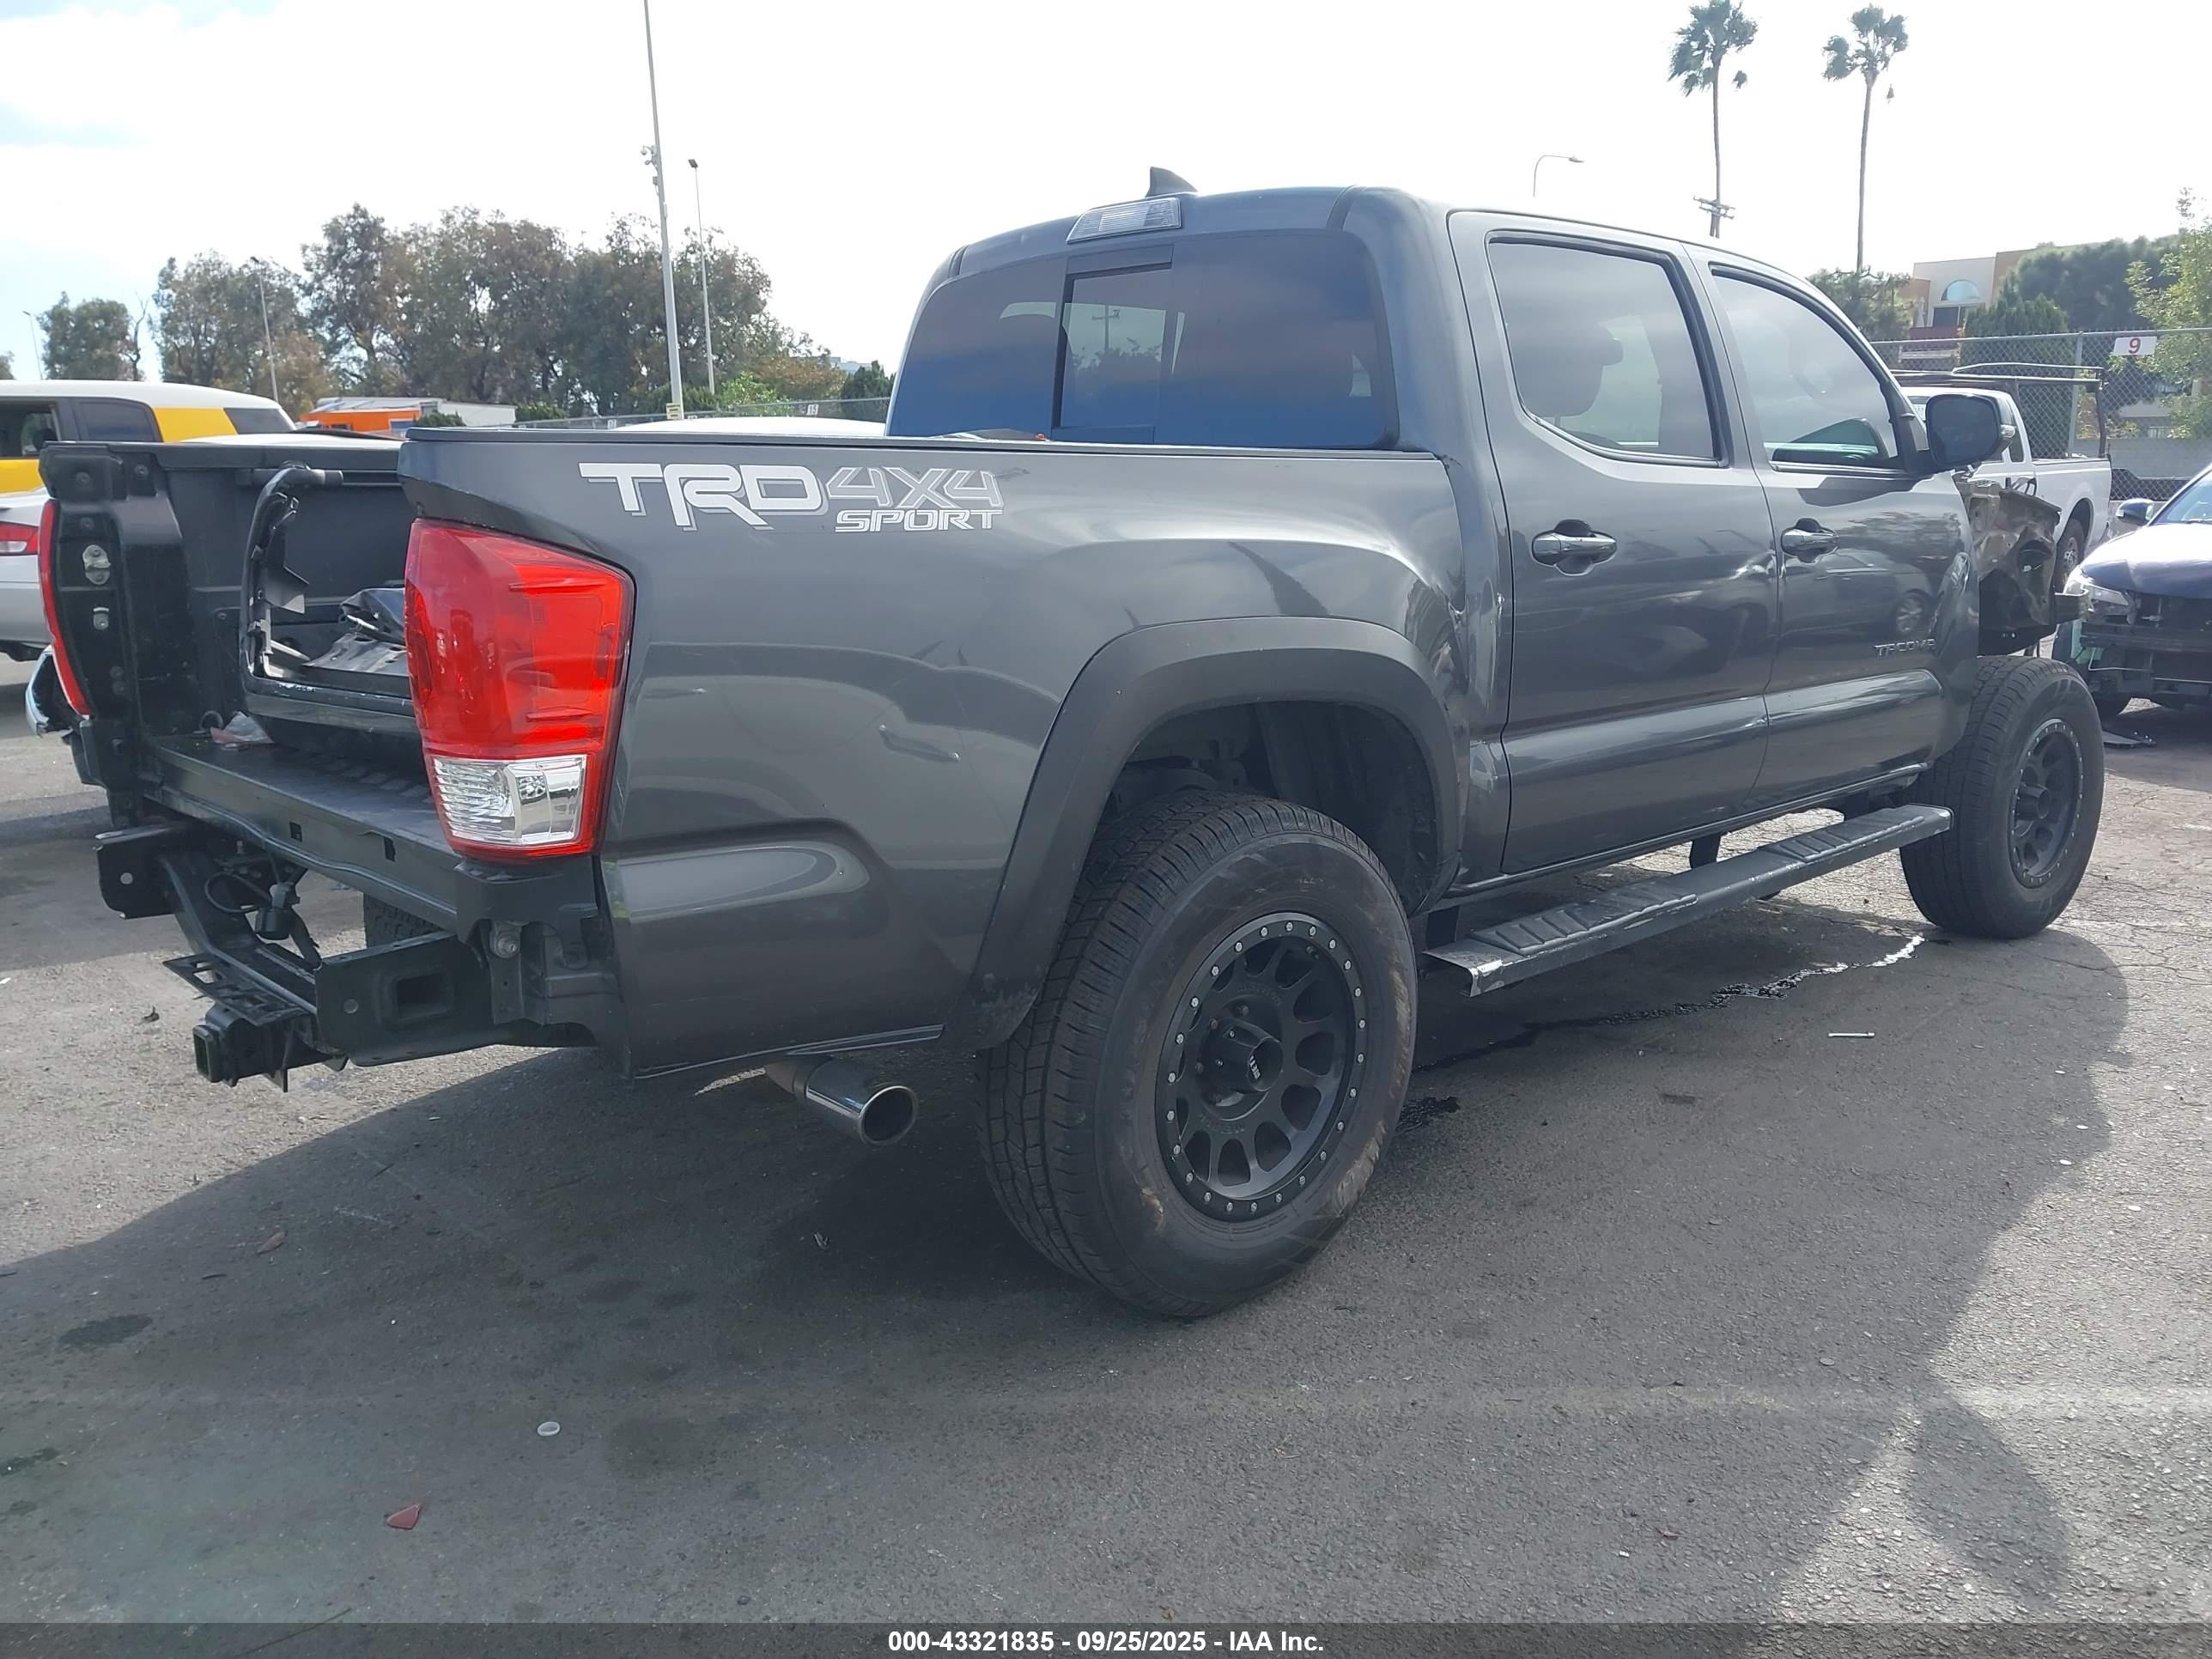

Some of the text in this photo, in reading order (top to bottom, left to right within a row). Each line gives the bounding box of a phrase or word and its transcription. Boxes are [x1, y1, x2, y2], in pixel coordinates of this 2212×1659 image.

[2128, 337, 2142, 354] 9
[578, 462, 828, 532] TRD
[835, 508, 1006, 532] SPORT
